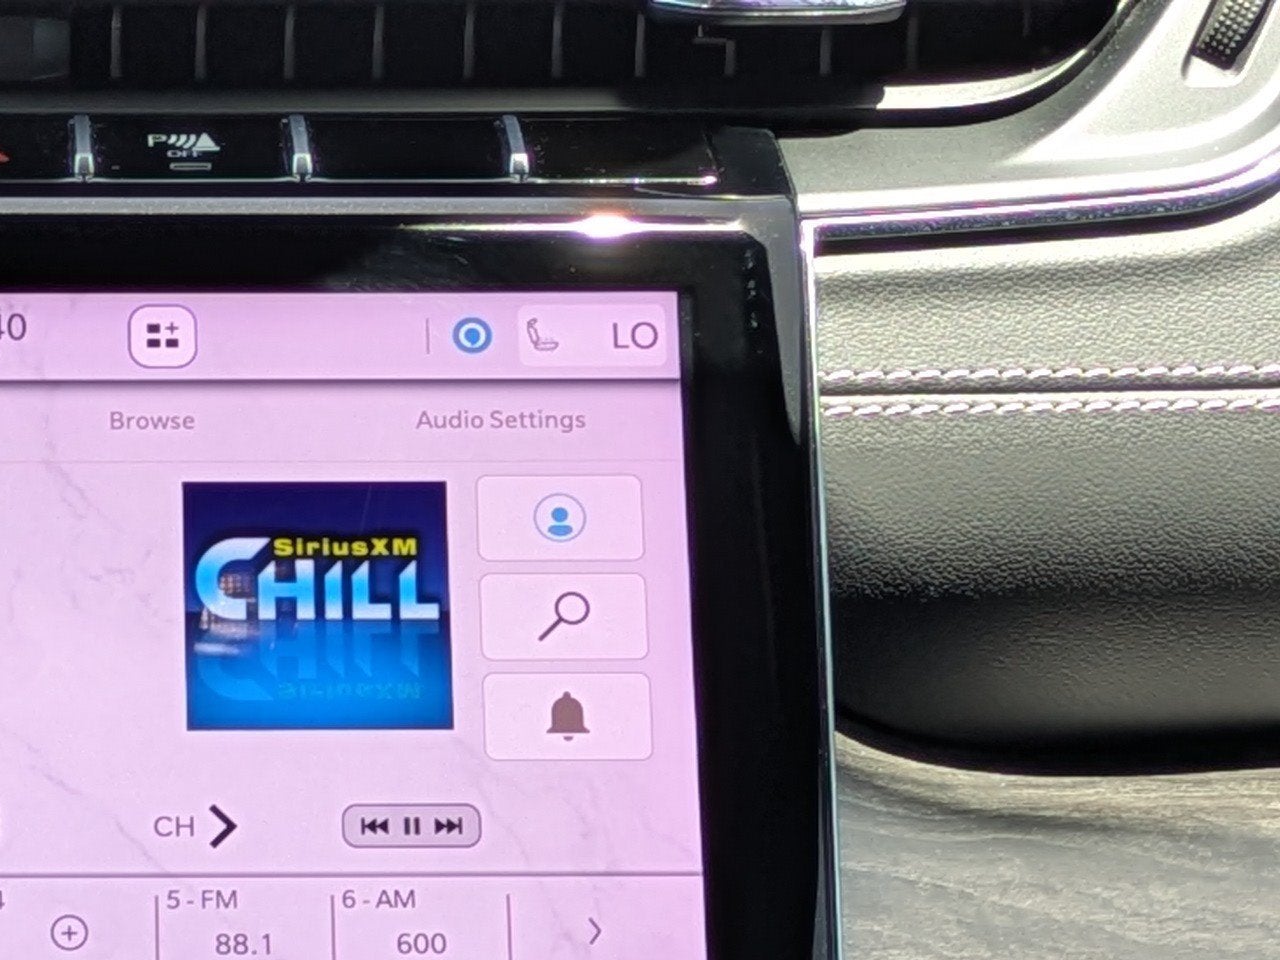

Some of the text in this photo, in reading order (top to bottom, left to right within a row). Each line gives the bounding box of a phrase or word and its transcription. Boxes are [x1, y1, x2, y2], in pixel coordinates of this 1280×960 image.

[612, 321, 659, 350] LO
[110, 411, 196, 431] Browse
[416, 410, 586, 434] Audio Settings
[273, 537, 418, 557] SiriusXM
[195, 537, 440, 620] CHILL
[153, 816, 195, 838] CH
[166, 890, 180, 909] 5
[201, 890, 238, 909] FM
[341, 890, 356, 909] 6
[375, 890, 417, 909] AM
[215, 933, 273, 955] 88.1
[396, 932, 448, 955] 600
